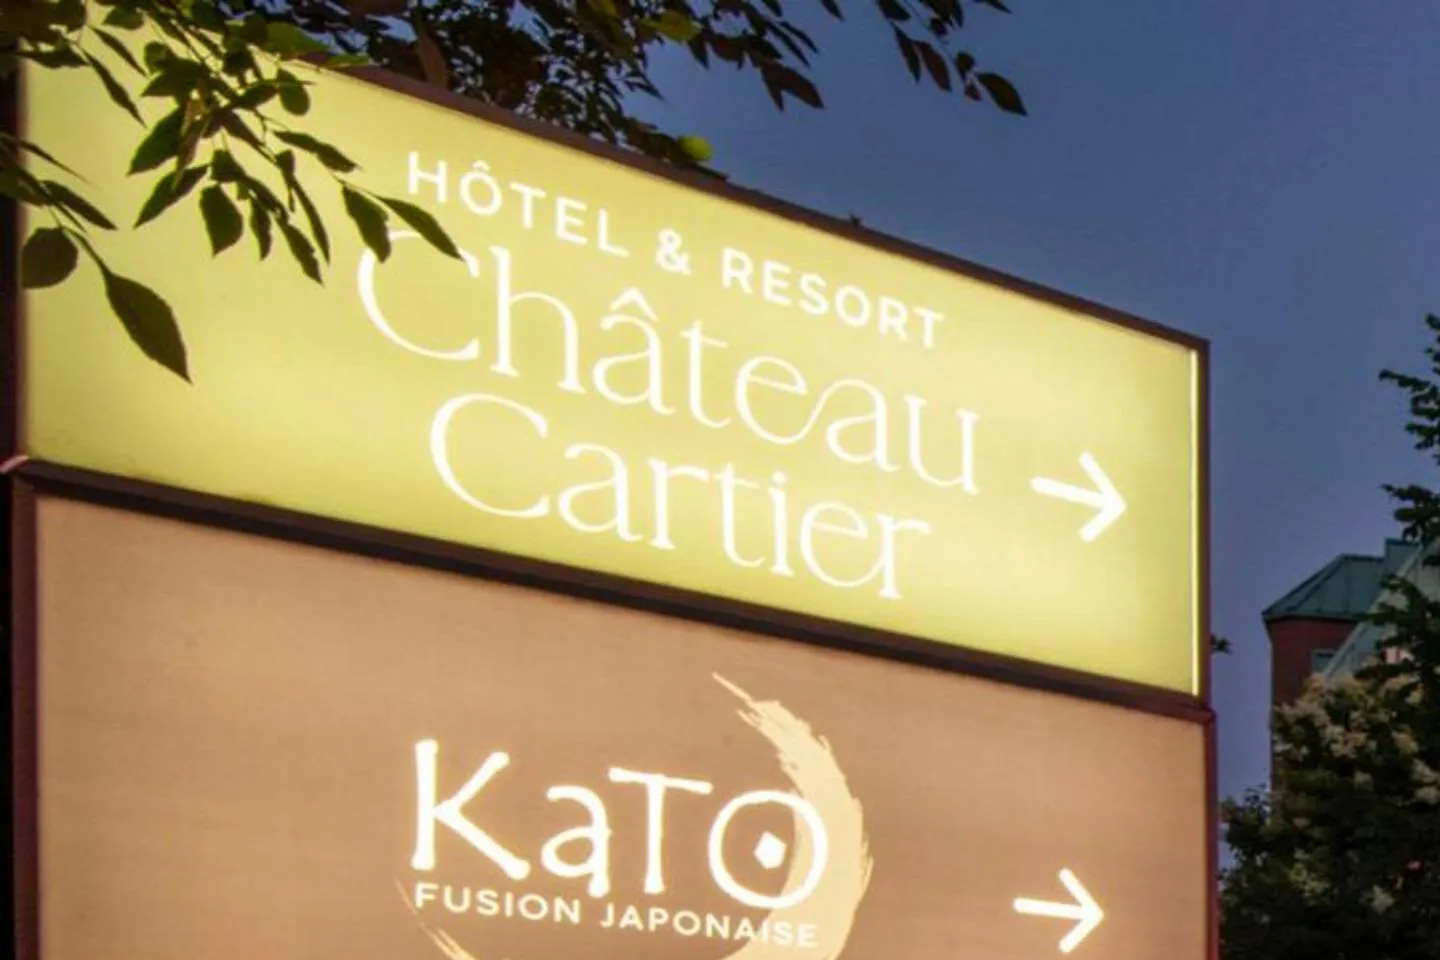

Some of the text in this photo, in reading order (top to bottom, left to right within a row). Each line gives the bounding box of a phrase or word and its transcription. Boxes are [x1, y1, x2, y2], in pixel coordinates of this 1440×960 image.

[405, 151, 945, 351] HÔTEL & RESORT
[356, 229, 981, 495] Château
[429, 392, 933, 600] Cartier
[413, 881, 820, 950] FUSION JAPONAISE
